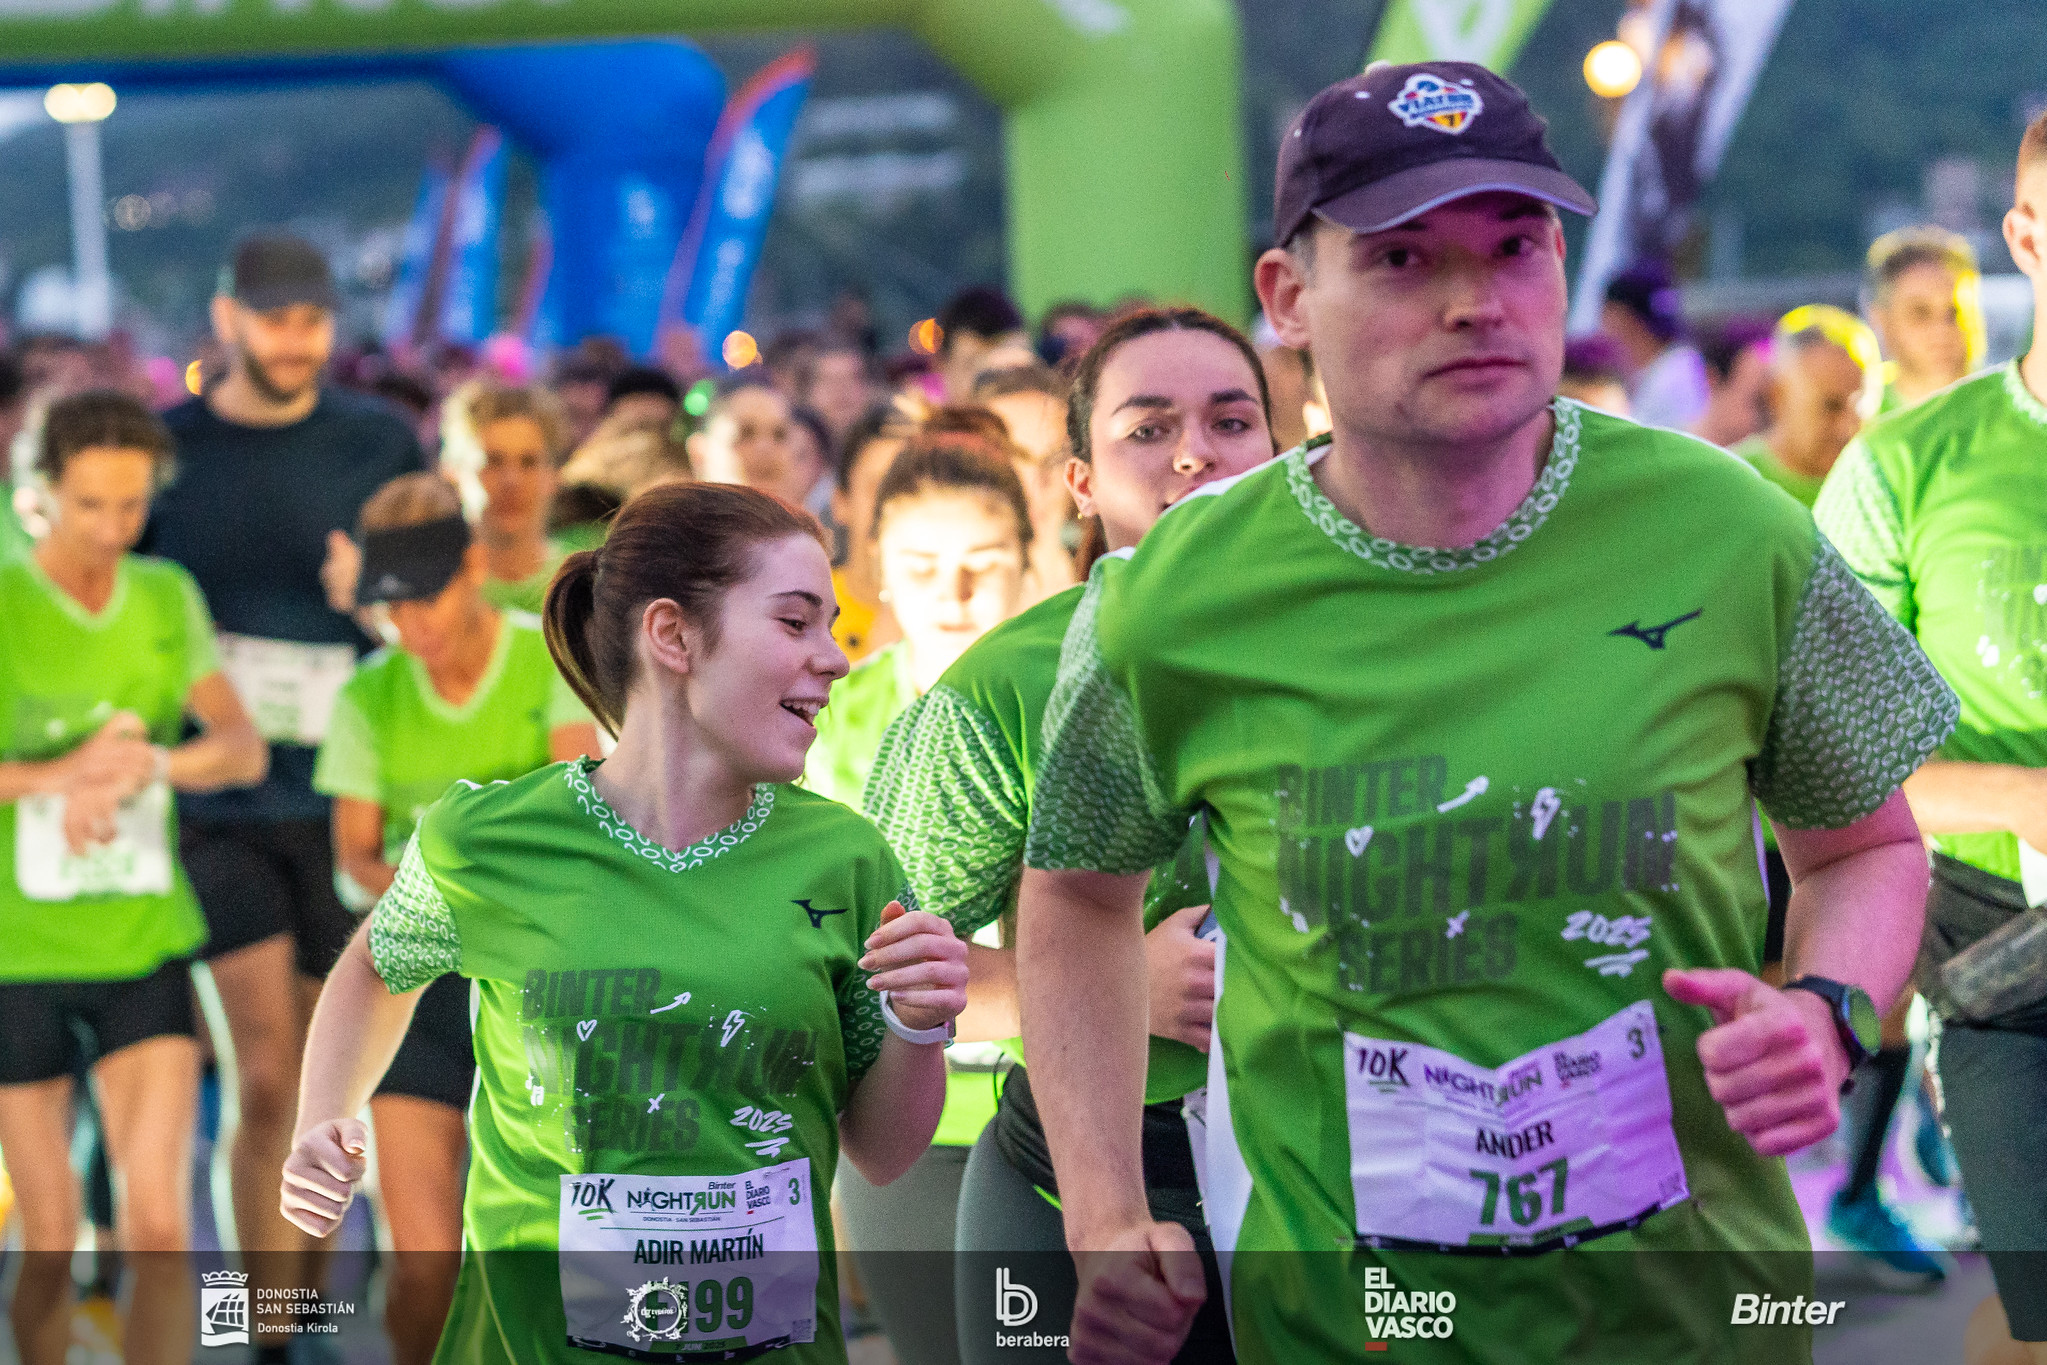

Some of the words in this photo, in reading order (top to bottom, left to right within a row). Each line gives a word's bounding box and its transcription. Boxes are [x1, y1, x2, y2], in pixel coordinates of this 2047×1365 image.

[1561, 911, 1652, 948] 2025
[522, 968, 660, 1020] BINTER
[1626, 1027, 1645, 1060] 3
[1356, 1047, 1411, 1088] 10K
[730, 1106, 793, 1134] 2025
[1475, 1119, 1555, 1160] ANDER
[570, 1178, 616, 1215] 10K
[708, 1181, 737, 1190] Binter
[745, 1180, 755, 1190] EL
[746, 1185, 770, 1200] DIARIO
[746, 1196, 771, 1209] VASCO
[788, 1177, 800, 1205] 3
[1469, 1157, 1569, 1227] 767
[633, 1238, 684, 1265] ADIR
[690, 1228, 764, 1265] MARTÍN
